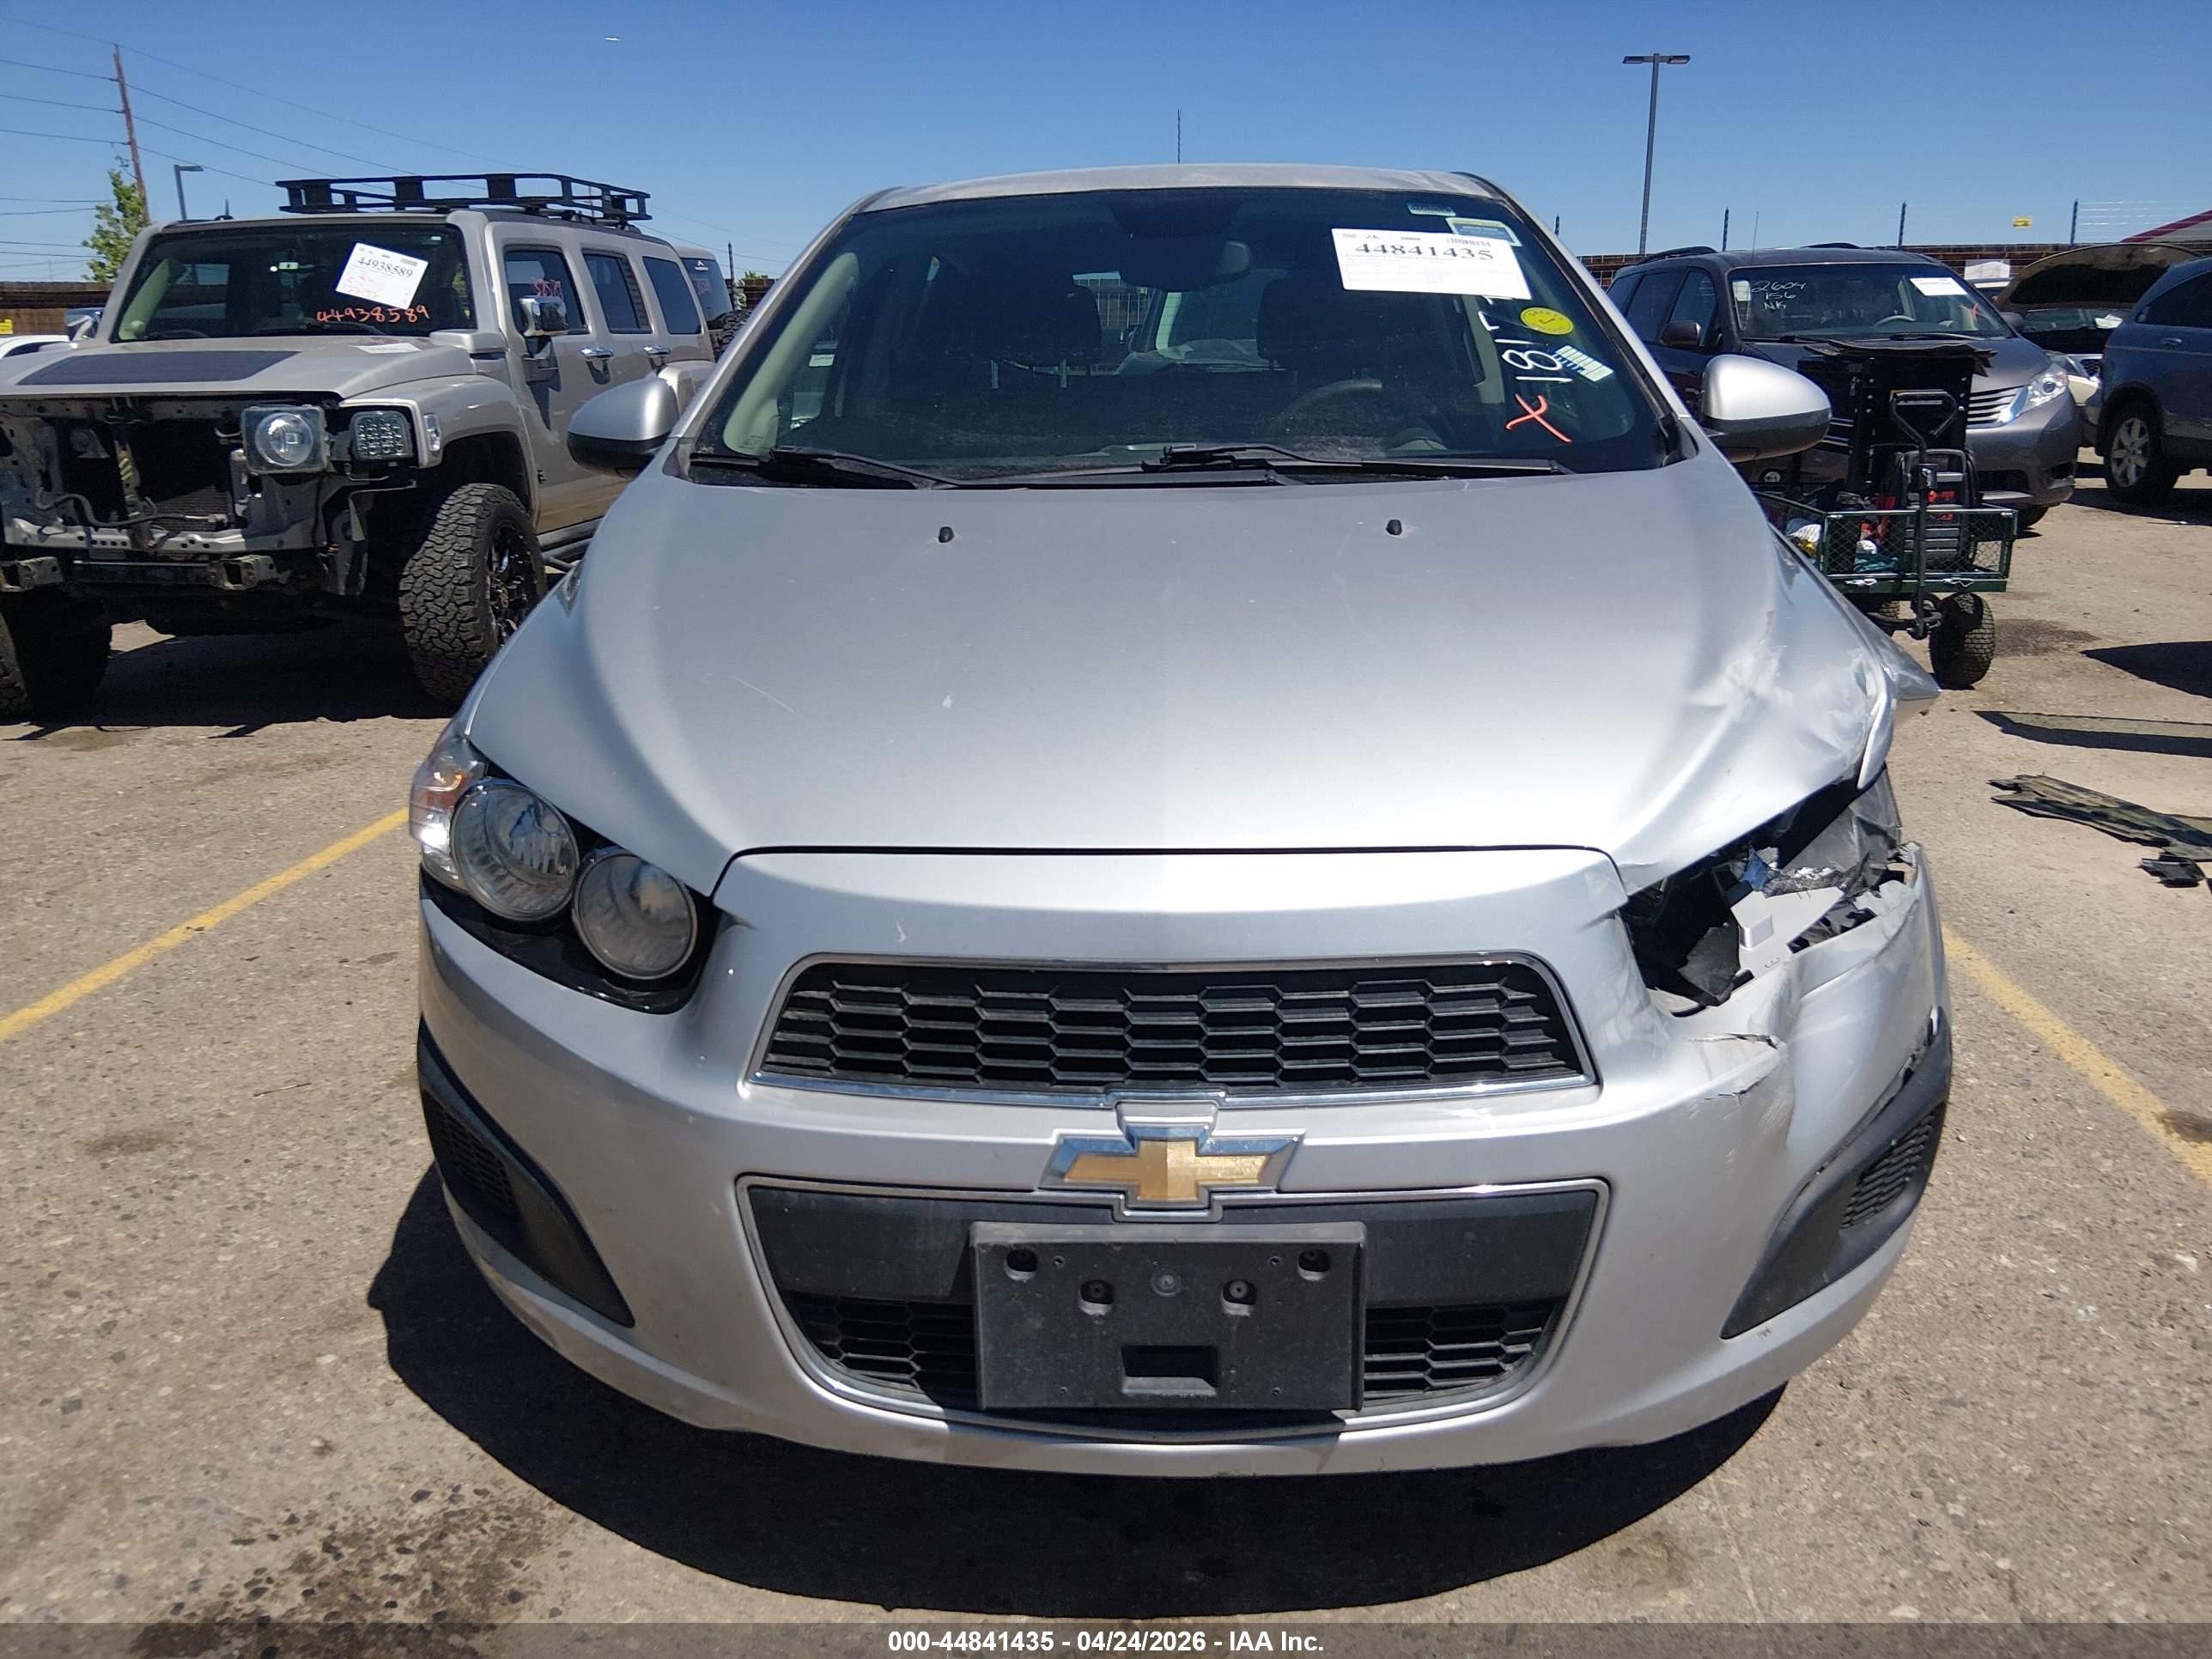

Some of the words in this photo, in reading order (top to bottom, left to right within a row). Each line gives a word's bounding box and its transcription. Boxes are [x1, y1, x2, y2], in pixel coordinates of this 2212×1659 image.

[1355, 243, 1493, 261] 44841435
[357, 256, 413, 278] 44938589
[316, 305, 430, 323] 44938589
